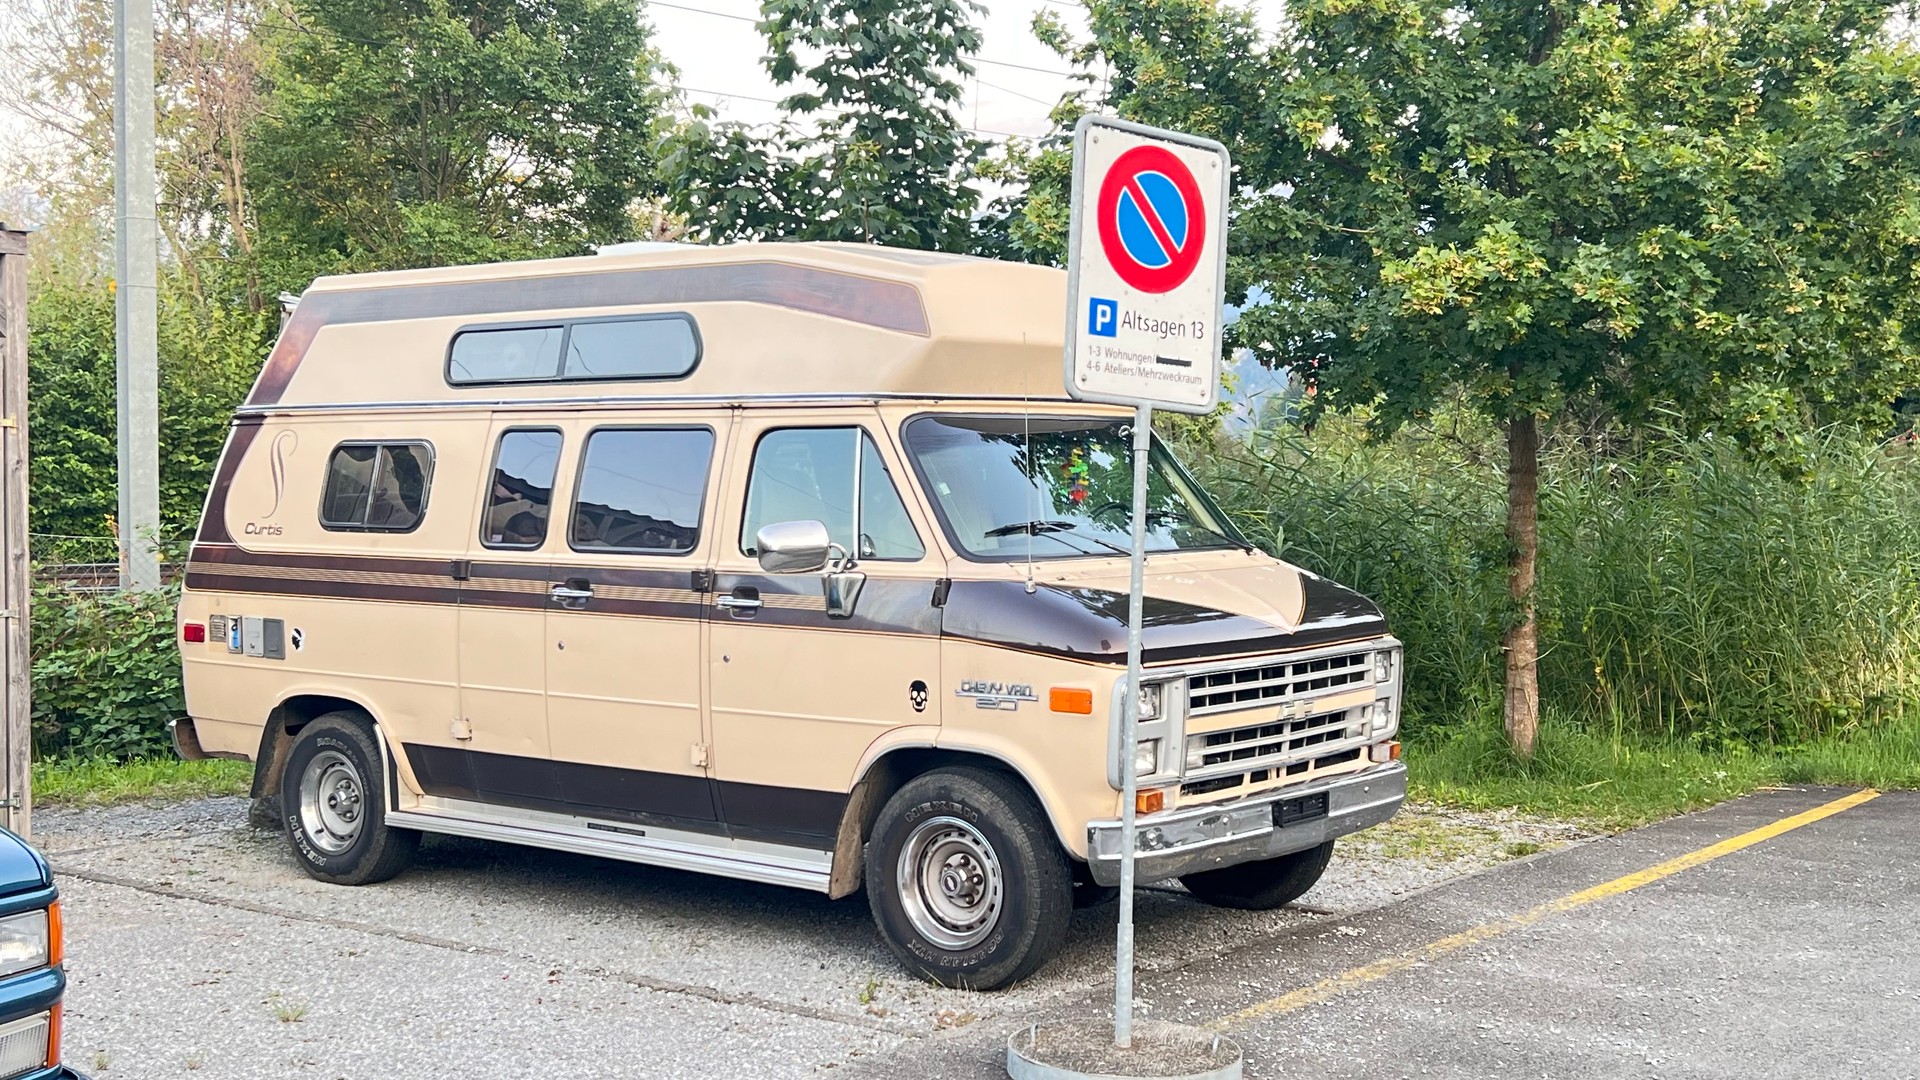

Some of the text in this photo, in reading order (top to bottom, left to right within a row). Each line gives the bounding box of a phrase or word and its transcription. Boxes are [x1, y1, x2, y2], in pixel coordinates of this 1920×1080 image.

[1121, 310, 1186, 340] Altsagen
[1191, 321, 1204, 340] 13
[1088, 345, 1101, 357] 1-3
[1086, 360, 1202, 385] 4-6 Ateliers/Mehrzweckraum
[244, 522, 284, 536] Curtis
[905, 801, 979, 823] NEXEN
